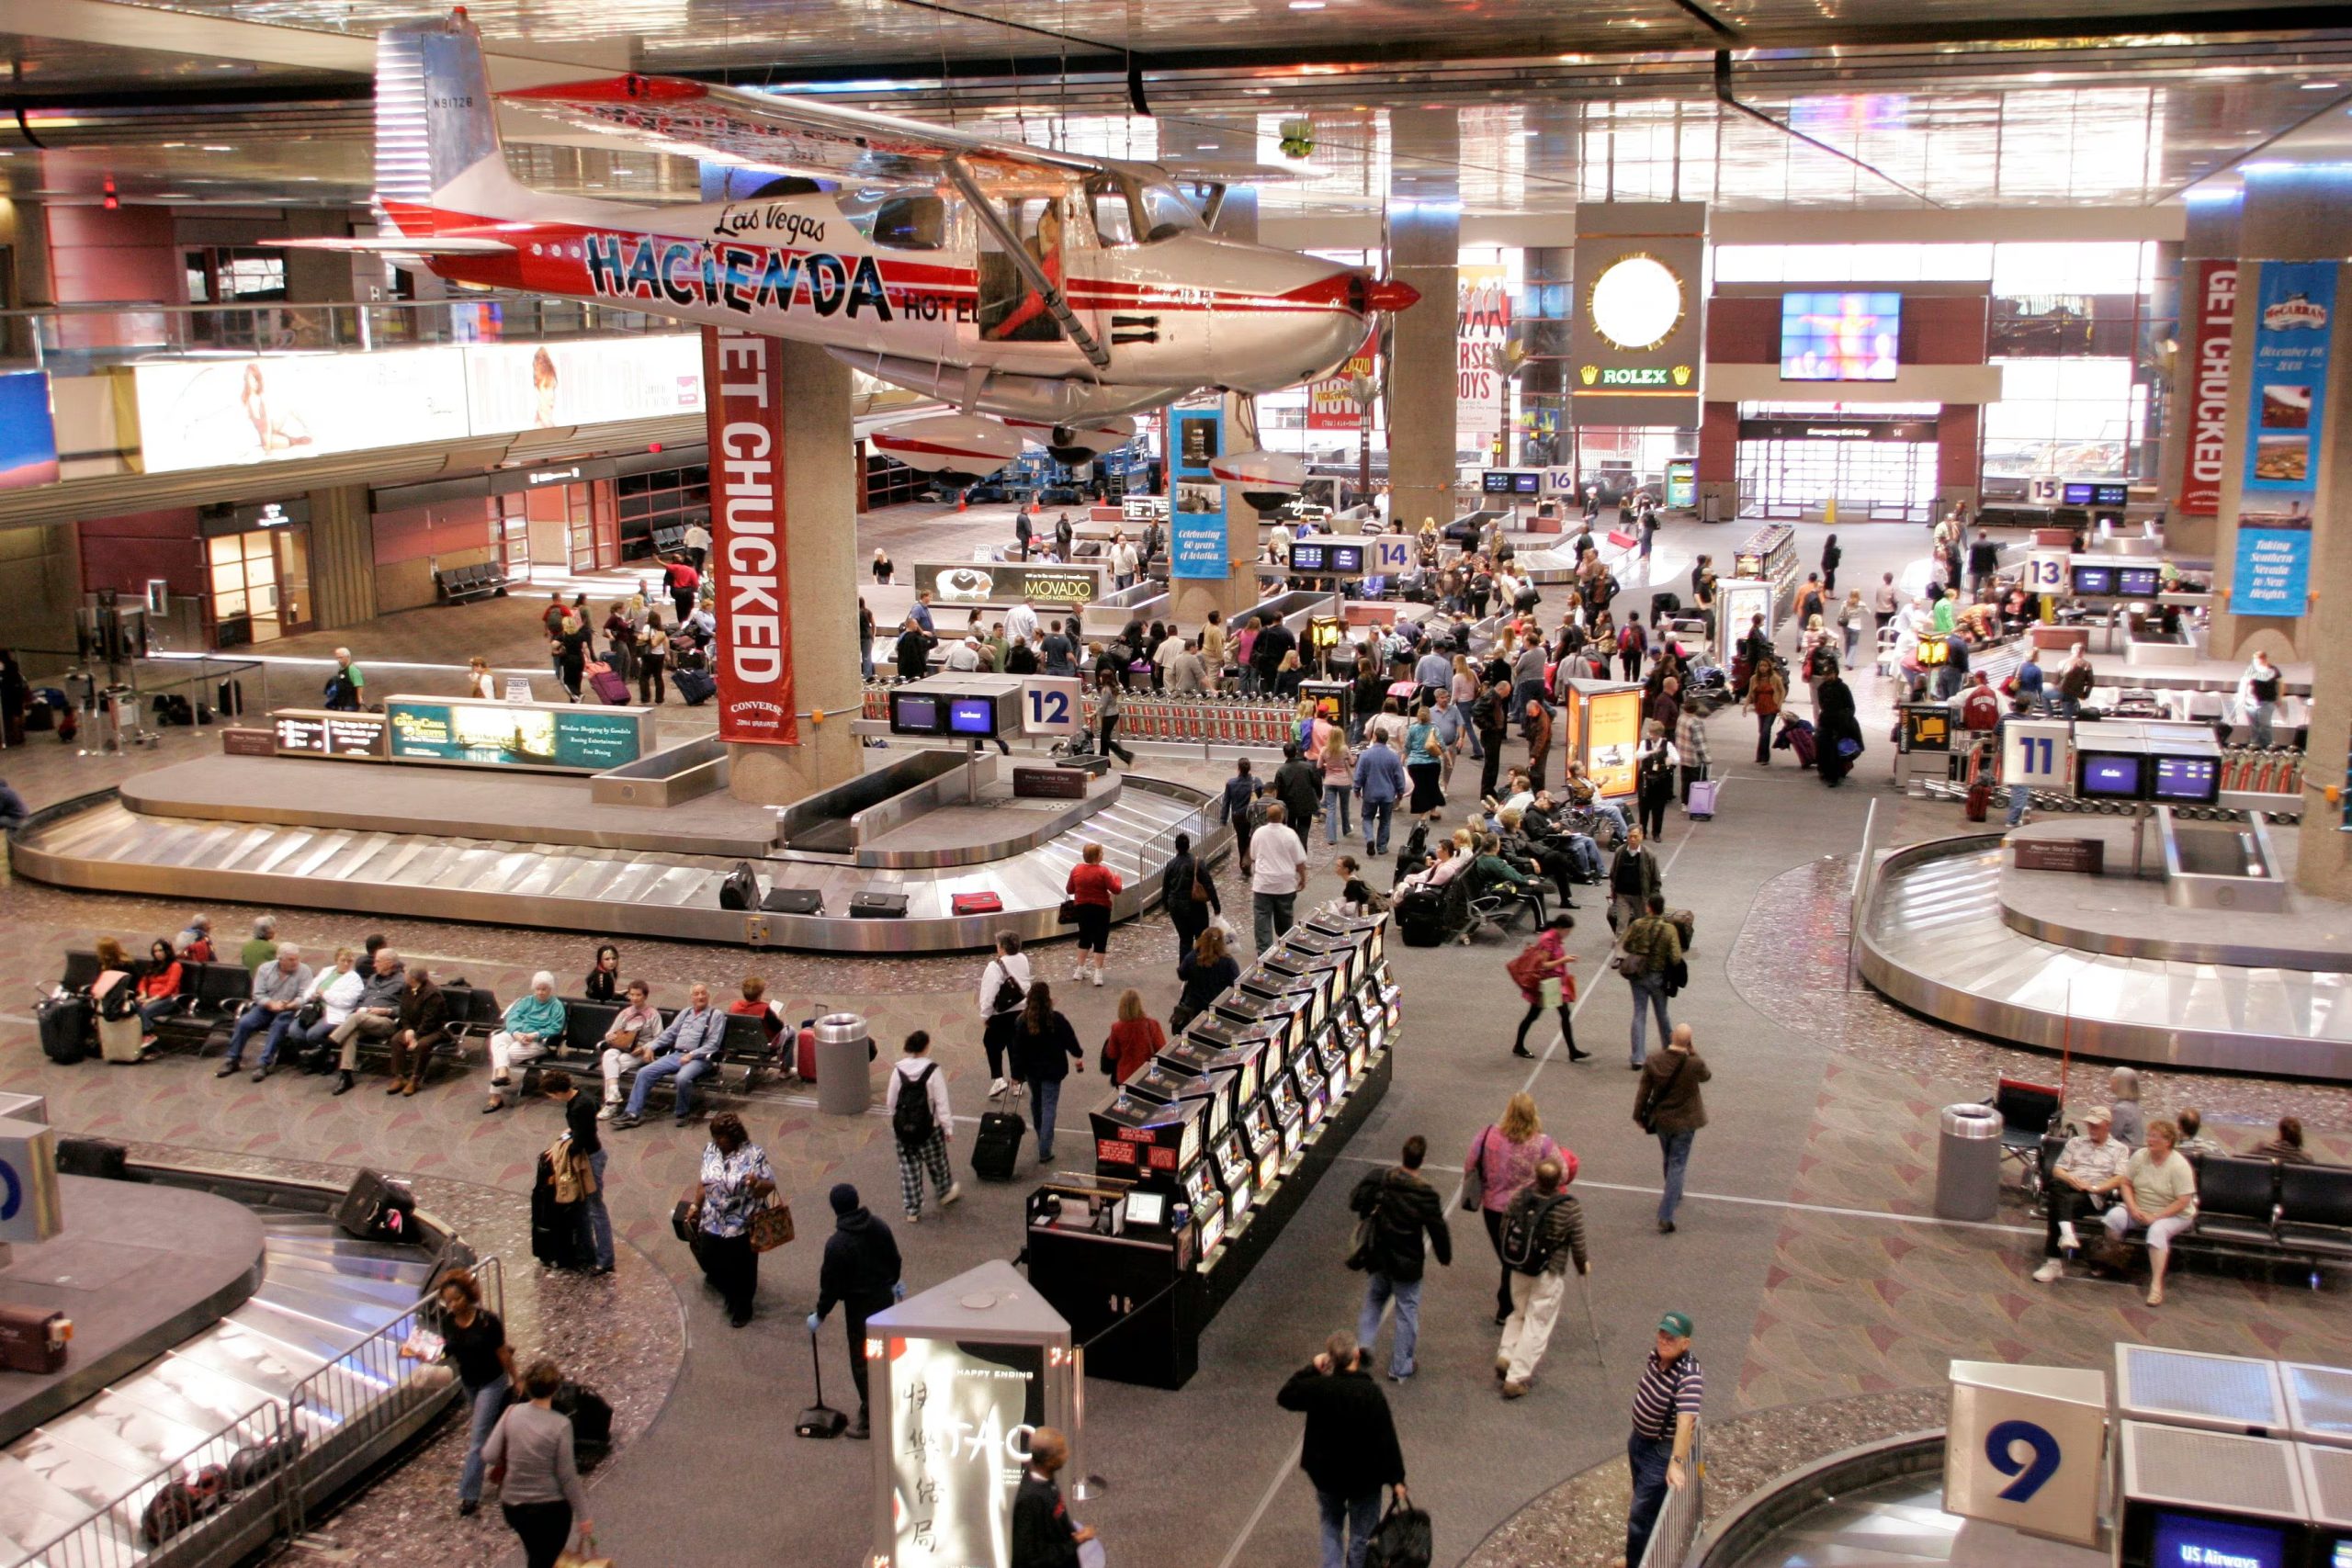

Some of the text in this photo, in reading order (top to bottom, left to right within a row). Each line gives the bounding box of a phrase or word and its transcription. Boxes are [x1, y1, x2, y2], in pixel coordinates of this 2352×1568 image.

[714, 204, 825, 246] Las Vegas
[585, 233, 894, 322] HACIENDA
[904, 295, 979, 323] HOTEL
[1455, 371, 1490, 399] OYS
[1603, 369, 1668, 384] ROLEX
[2194, 337, 2232, 482] CHUCKED
[1550, 472, 1571, 489] 16
[2034, 480, 2055, 498] 15
[718, 328, 781, 683] ET CHUCKED
[1179, 530, 1220, 540] Celebrating
[1194, 542, 1215, 550] years
[1380, 544, 1407, 565] 14
[2256, 539, 2291, 551] Taking
[2250, 553, 2294, 562] Southern
[2030, 560, 2060, 584] 13
[2253, 564, 2290, 574] Nevada
[1024, 581, 1091, 596] MOVADO
[2249, 589, 2287, 600] Heights
[730, 701, 784, 716] CONVERSE
[1028, 690, 1069, 723] 12
[2019, 737, 2052, 774] 11
[956, 1369, 1034, 1379] HAPPY ENDING
[1984, 1420, 2061, 1503] 9
[2181, 1544, 2259, 1568] US Airways
